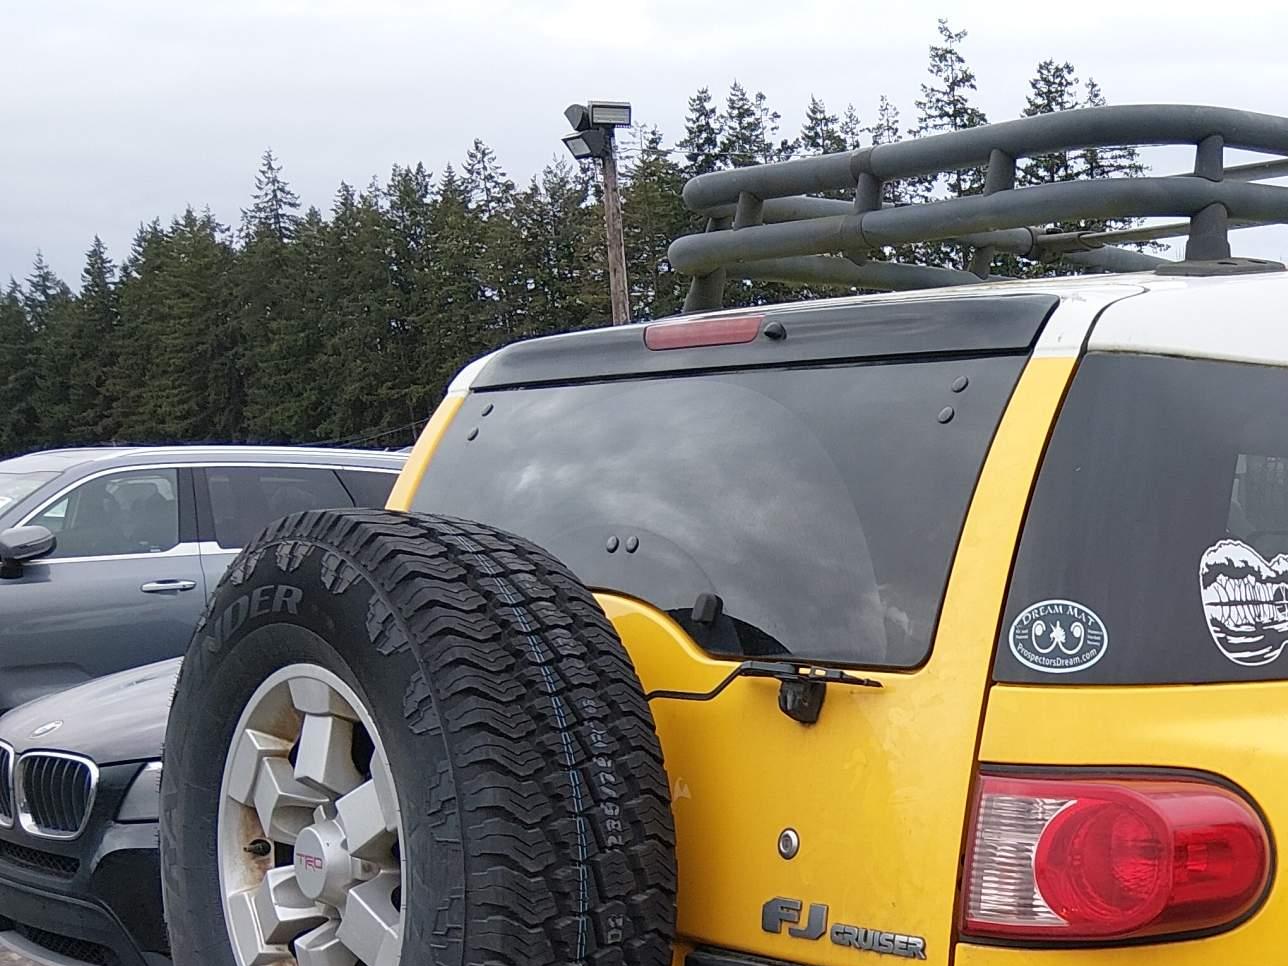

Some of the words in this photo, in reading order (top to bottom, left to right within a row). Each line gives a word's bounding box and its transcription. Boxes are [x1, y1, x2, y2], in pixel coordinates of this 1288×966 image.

[1021, 604, 1063, 625] DREAM
[1066, 605, 1095, 627] MAT
[1016, 642, 1098, 667] ProspectorsDream.com
[296, 853, 323, 872] TRD
[762, 896, 829, 940] FJ
[831, 923, 927, 960] CRUISER
